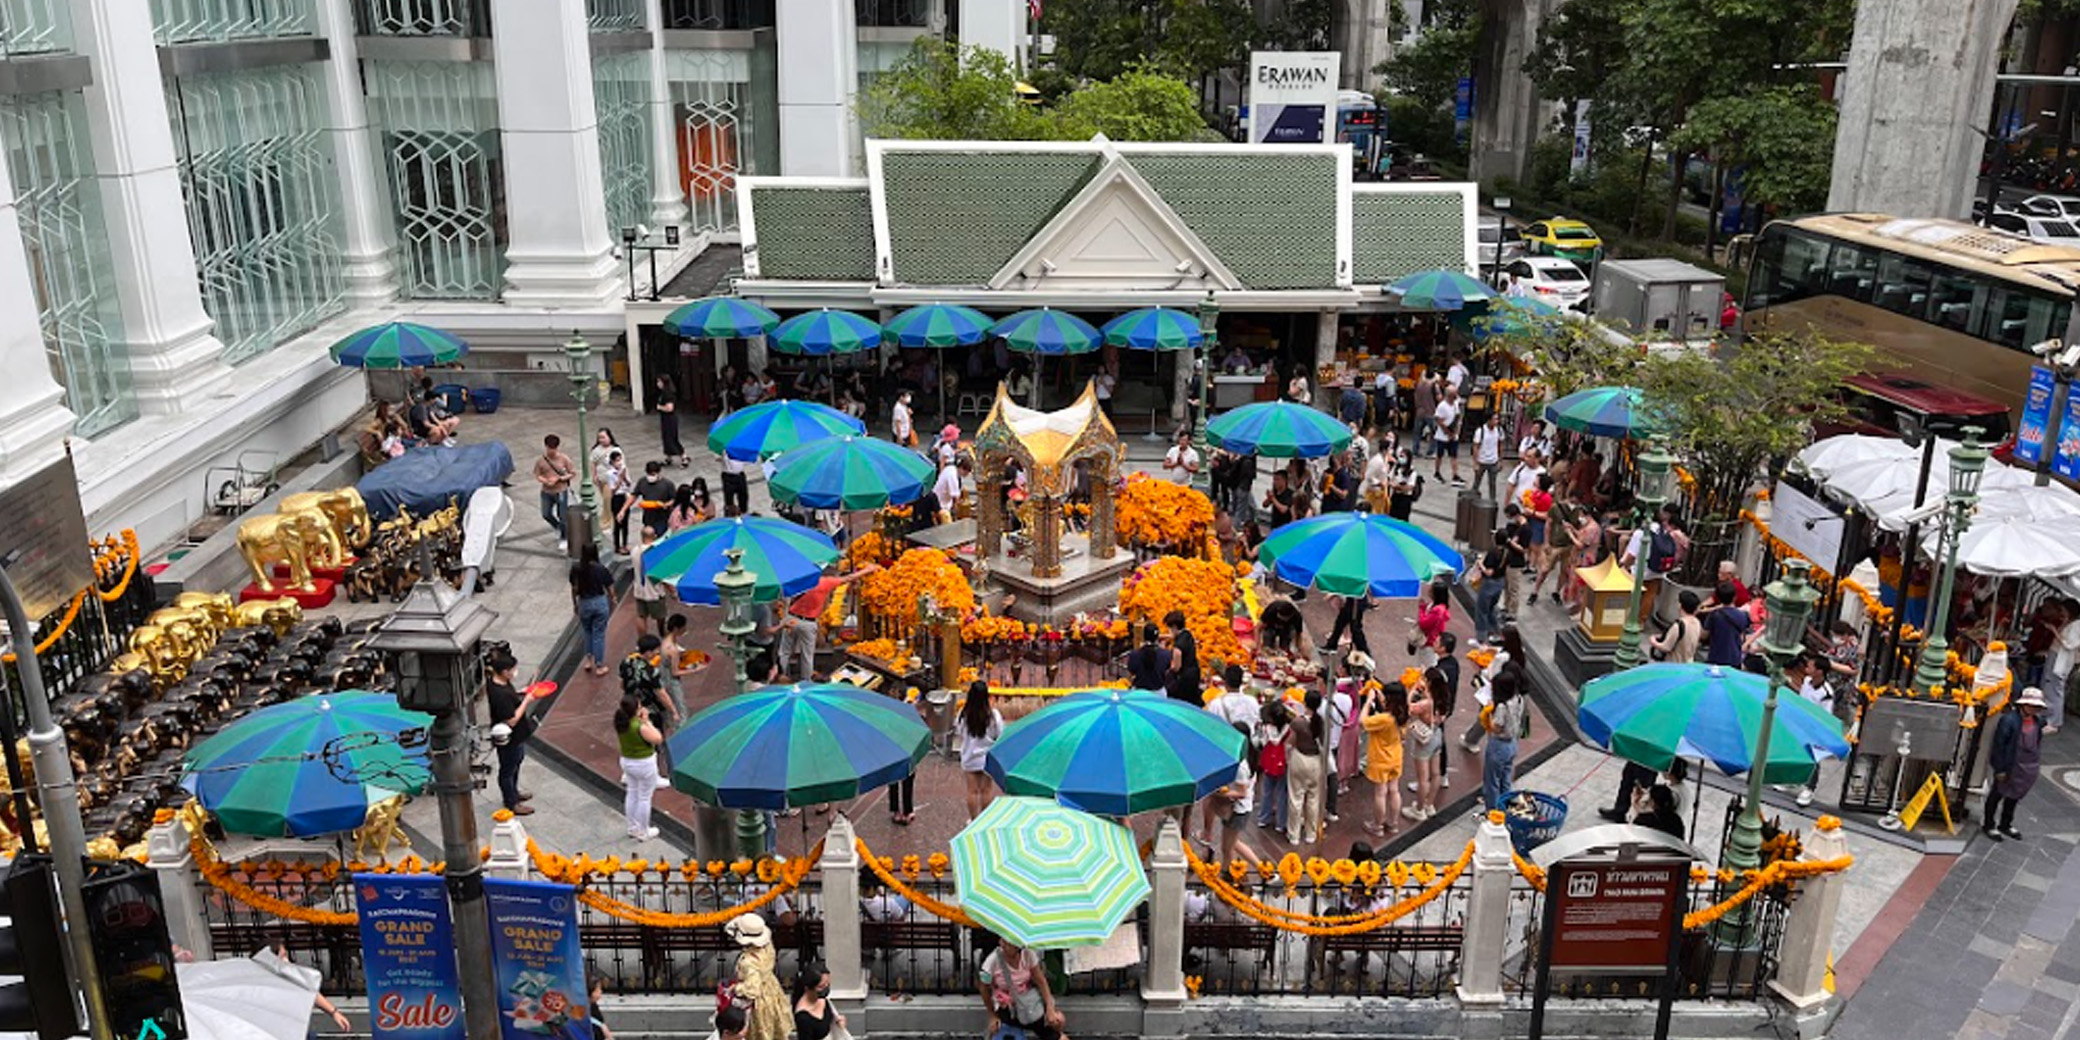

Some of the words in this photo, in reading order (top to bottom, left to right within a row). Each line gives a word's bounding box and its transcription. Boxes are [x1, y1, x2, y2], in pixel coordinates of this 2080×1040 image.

[1258, 65, 1328, 84] ERAWAN
[374, 920, 434, 933] GRAND
[504, 926, 563, 942] GRAND
[384, 933, 425, 945] SALE
[513, 939, 554, 953] SALE
[376, 991, 457, 1031] Sale
